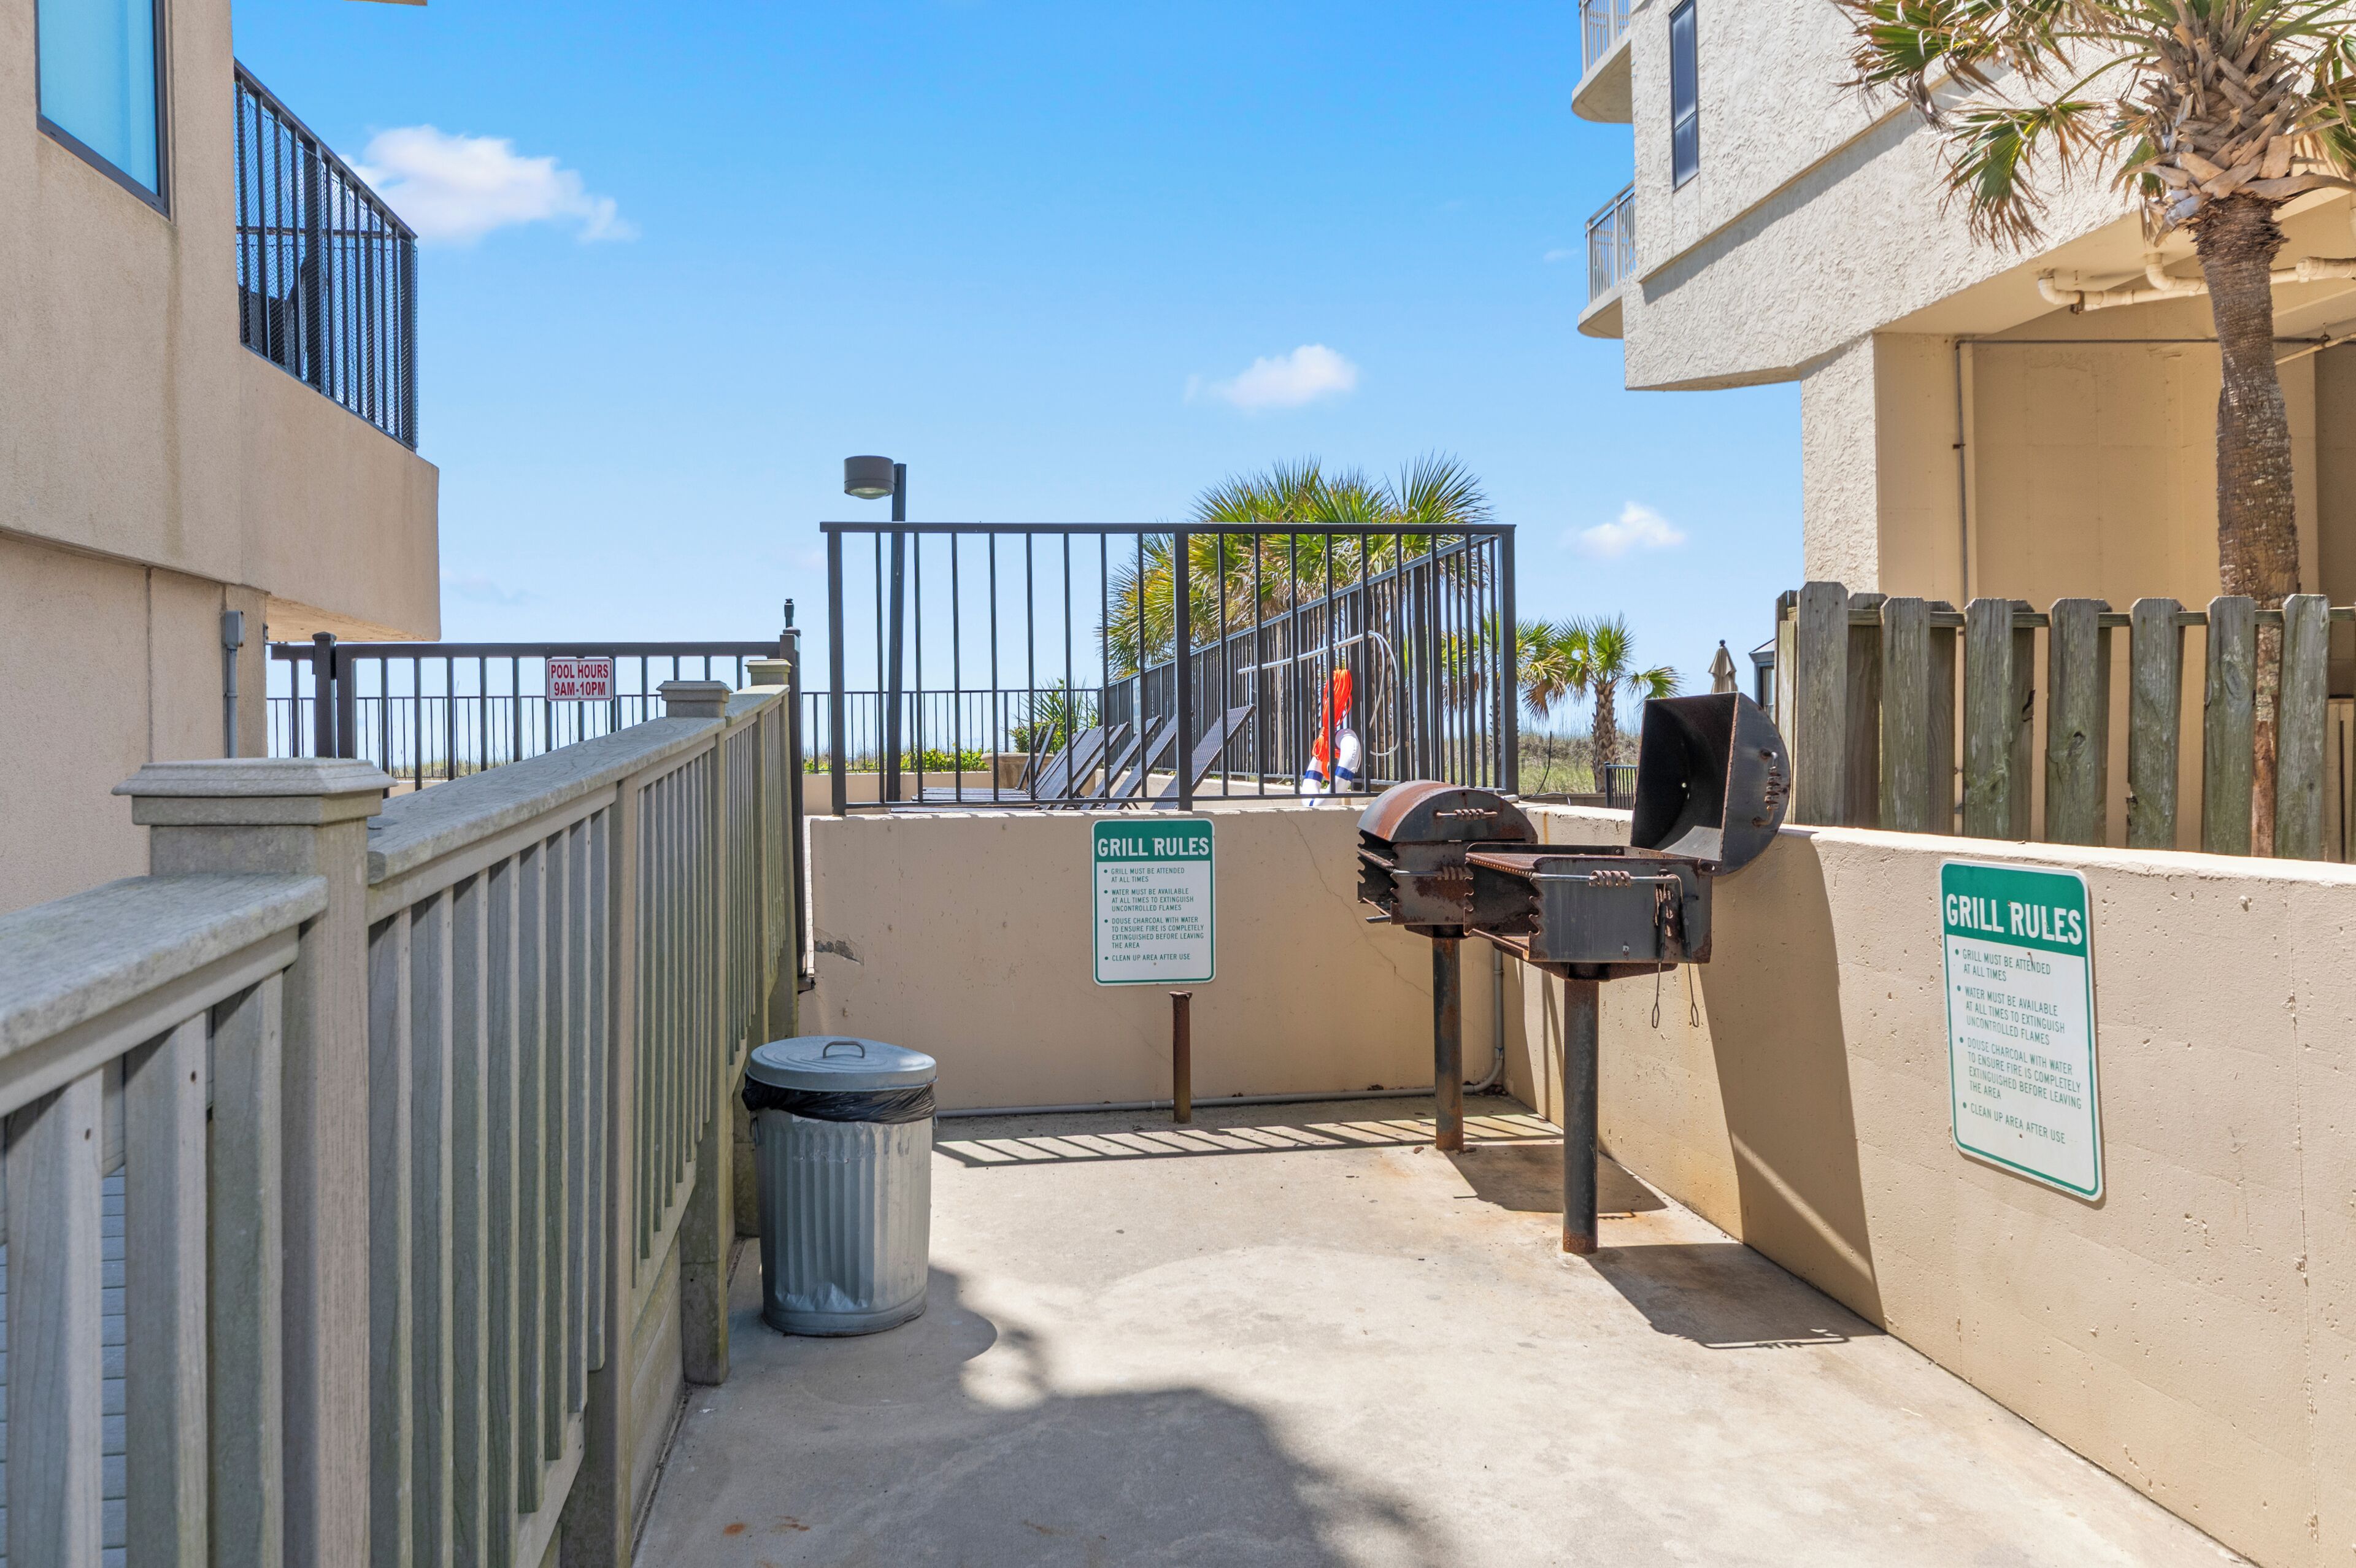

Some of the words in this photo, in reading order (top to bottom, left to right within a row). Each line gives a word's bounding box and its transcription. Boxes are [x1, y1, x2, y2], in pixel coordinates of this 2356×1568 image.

[551, 664, 574, 678] POOL
[578, 664, 608, 678] HOURS
[1098, 838, 1148, 856] GRILL
[1154, 837, 1209, 856] RULES
[1946, 894, 2004, 932] GRILL
[2011, 902, 2082, 945] RULES
[1963, 949, 1981, 962] GRILL
[1984, 953, 2001, 965] MUST
[2004, 958, 2012, 967] BE
[2016, 959, 2050, 975] ATTENDED
[1964, 964, 1971, 974] AT
[1973, 966, 1984, 977] ALL
[1987, 968, 2006, 982] TIMES
[1965, 986, 1984, 1000] WATER
[1988, 991, 2004, 1004] MUST
[2008, 996, 2015, 1007] BE
[2019, 998, 2058, 1016] AVAILABLE
[1966, 1002, 1973, 1012] AT
[1975, 1004, 1987, 1015] ALL
[1989, 1006, 2008, 1020] TIMES
[2011, 1012, 2019, 1022] TO
[2022, 1014, 2065, 1033] EXTINGUISH
[1967, 1016, 2019, 1037] UNCONTROLLED
[2022, 1029, 2050, 1045] FLAMES
[1968, 1037, 1989, 1052] DOUSE
[1992, 1044, 2027, 1063] CHARCOAL
[2030, 1055, 2047, 1068] WITH
[2050, 1059, 2073, 1075] WATER
[1968, 1051, 1976, 1063] TO
[1978, 1055, 2004, 1071] ENSURE
[2007, 1063, 2022, 1076] FIRE
[2025, 1069, 2031, 1078] IS
[2035, 1070, 2081, 1093] COMPLETELY
[1969, 1066, 2017, 1090] EXTINGUISHED
[2020, 1082, 2047, 1099] BEFORE
[2050, 1090, 2081, 1109] LEAVING
[1970, 1081, 1981, 1093] THE
[1984, 1085, 2001, 1099] AREA
[1971, 1104, 1992, 1119] CLEAN
[1995, 1111, 2003, 1122] UP
[2006, 1115, 2023, 1130] AREA
[2027, 1123, 2047, 1138] AFTER
[2051, 1130, 2065, 1144] USE
